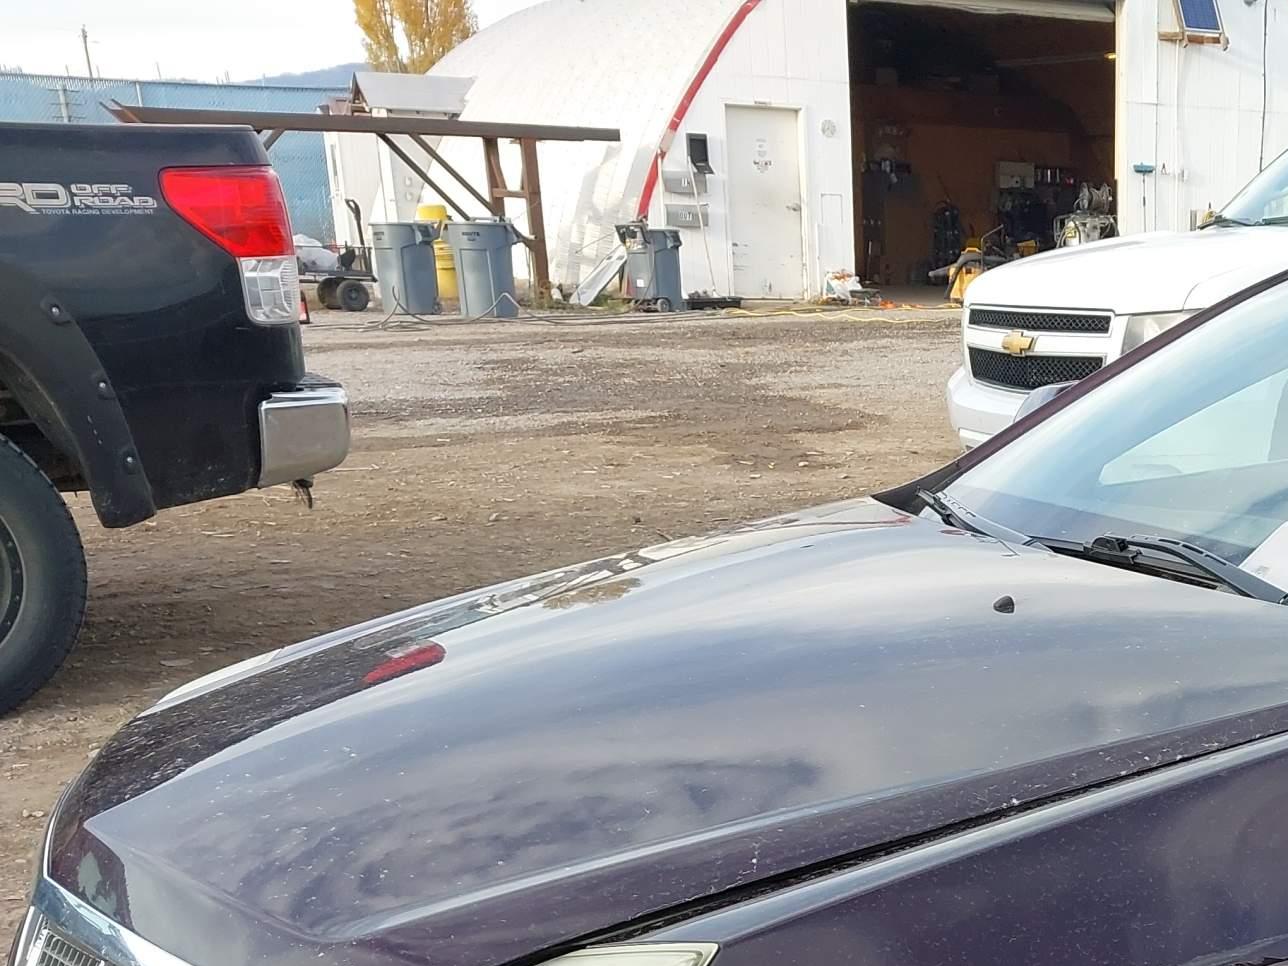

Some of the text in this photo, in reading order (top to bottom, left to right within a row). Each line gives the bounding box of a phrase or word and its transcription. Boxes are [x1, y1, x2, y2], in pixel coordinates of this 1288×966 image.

[70, 183, 133, 196] OFF
[74, 196, 158, 208] ROAD
[101, 208, 154, 216] DEVELOPMENT
